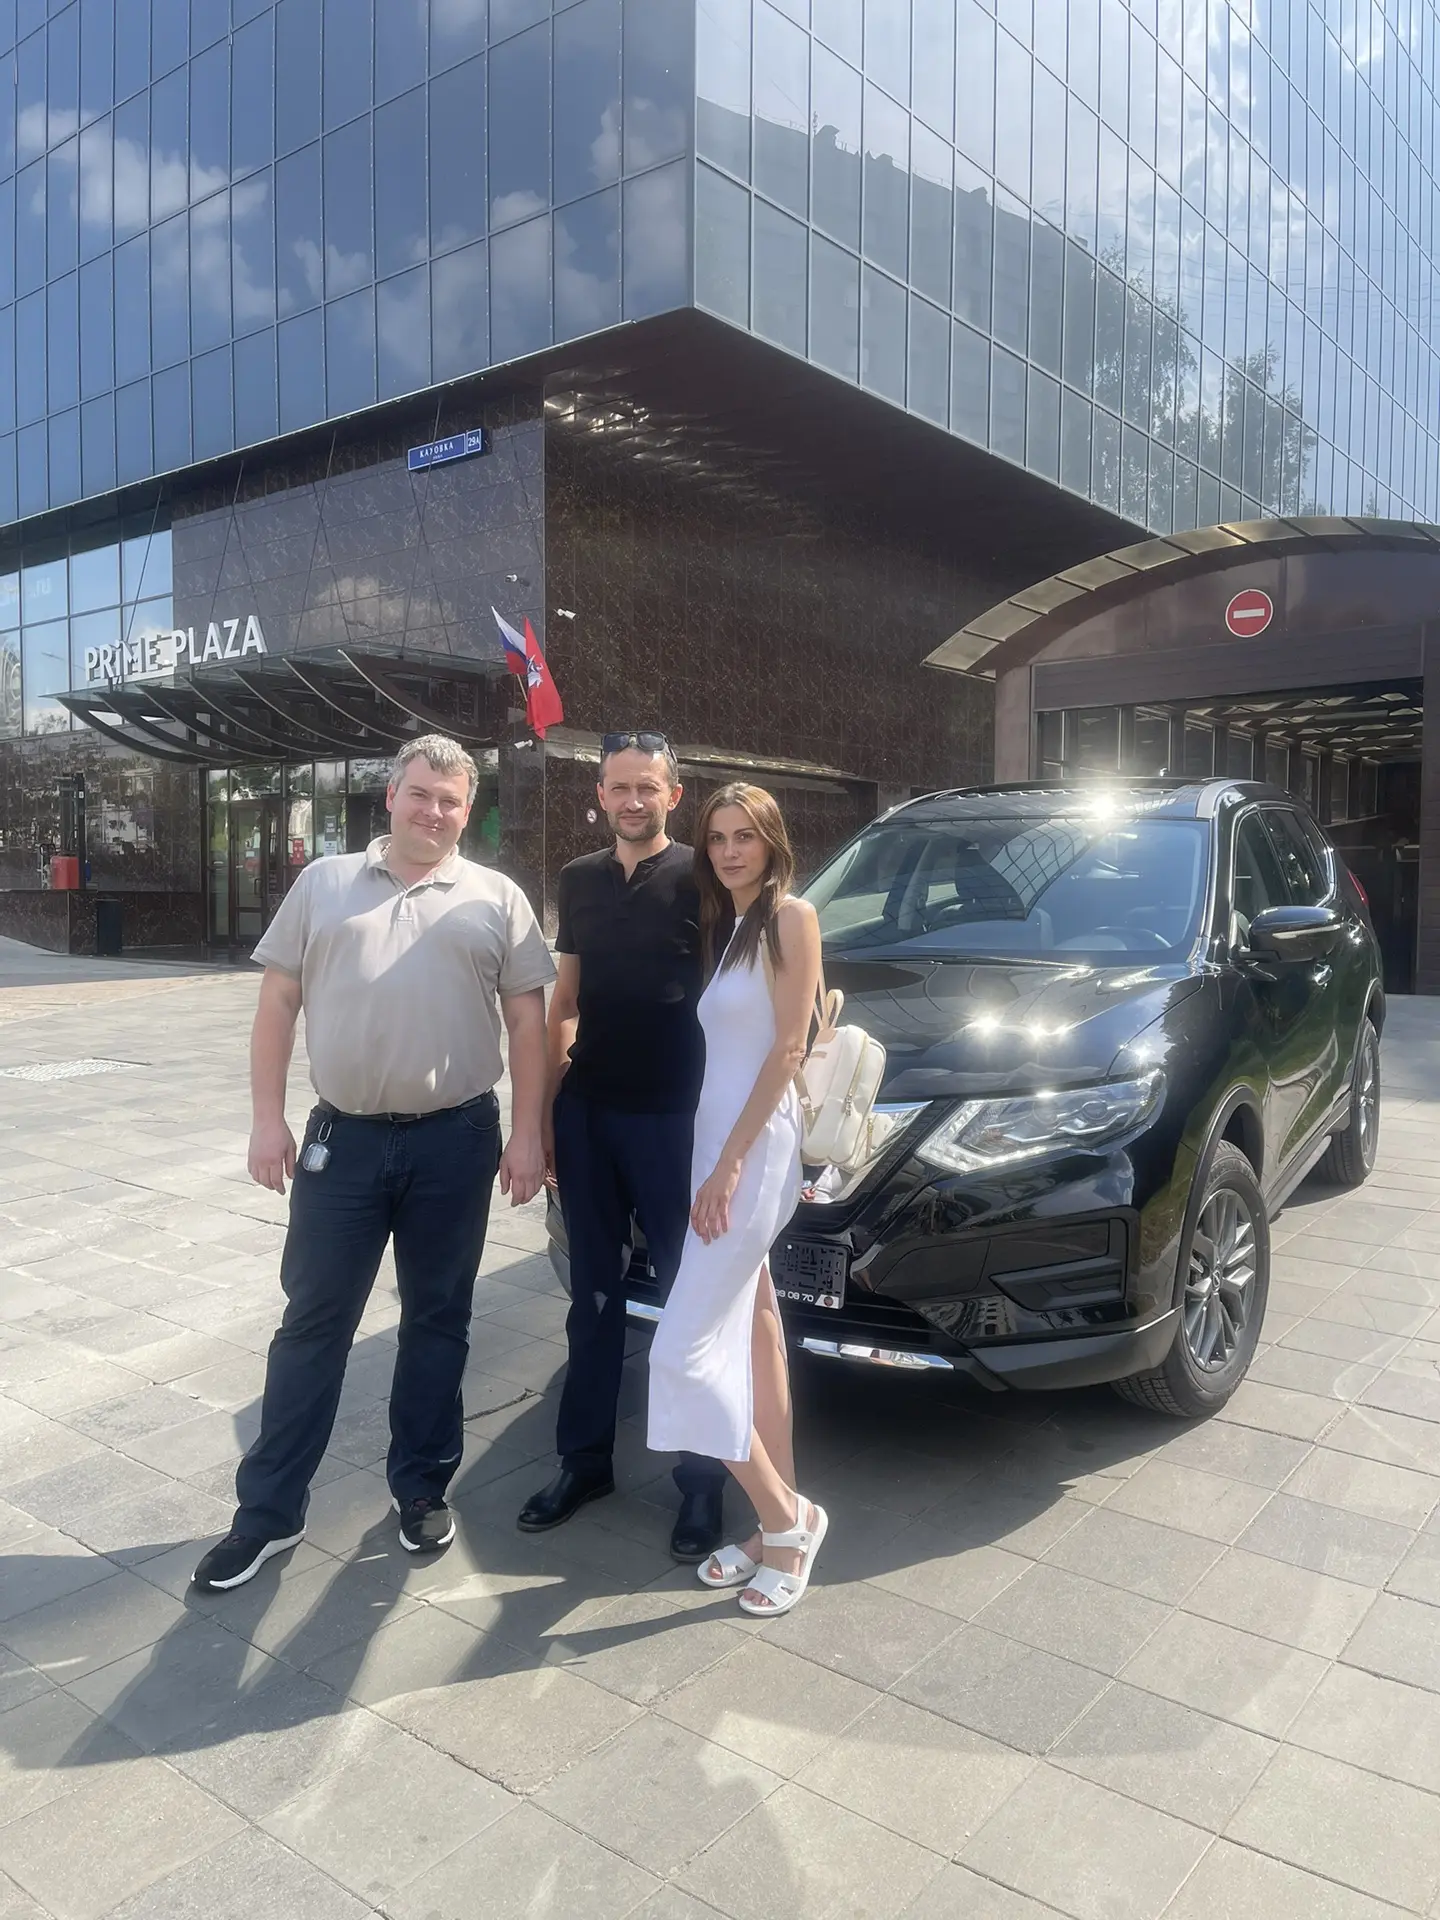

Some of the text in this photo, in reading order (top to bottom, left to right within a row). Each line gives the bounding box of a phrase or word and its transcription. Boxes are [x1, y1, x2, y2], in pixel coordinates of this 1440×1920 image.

[85, 615, 268, 681] PRIME PLAZA
[801, 1293, 814, 1302] 70
